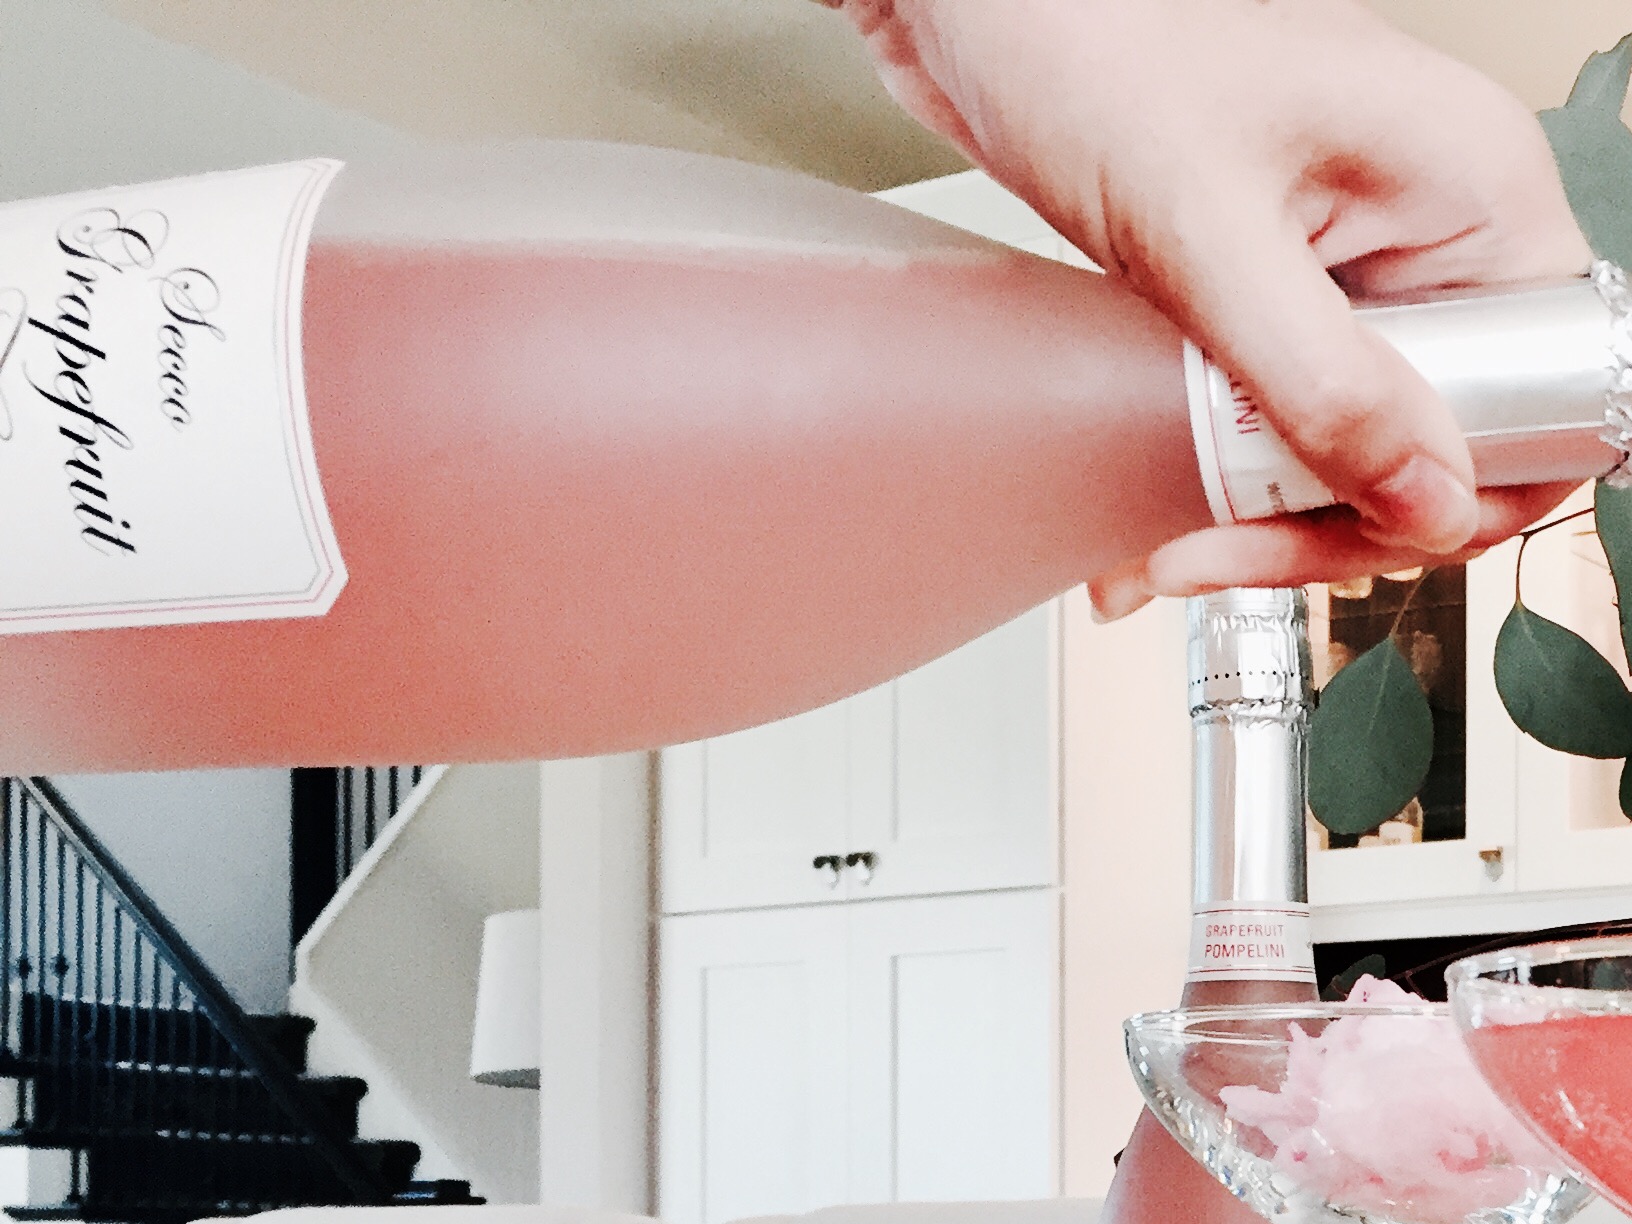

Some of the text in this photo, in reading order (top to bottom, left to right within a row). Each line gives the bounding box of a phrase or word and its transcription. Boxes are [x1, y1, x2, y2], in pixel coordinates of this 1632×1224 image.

[22, 207, 170, 557] Grapefruit
[148, 266, 226, 433] Secco
[1204, 943, 1286, 959] POMPELINI
[1205, 924, 1285, 938] GRAPEFRUIT
